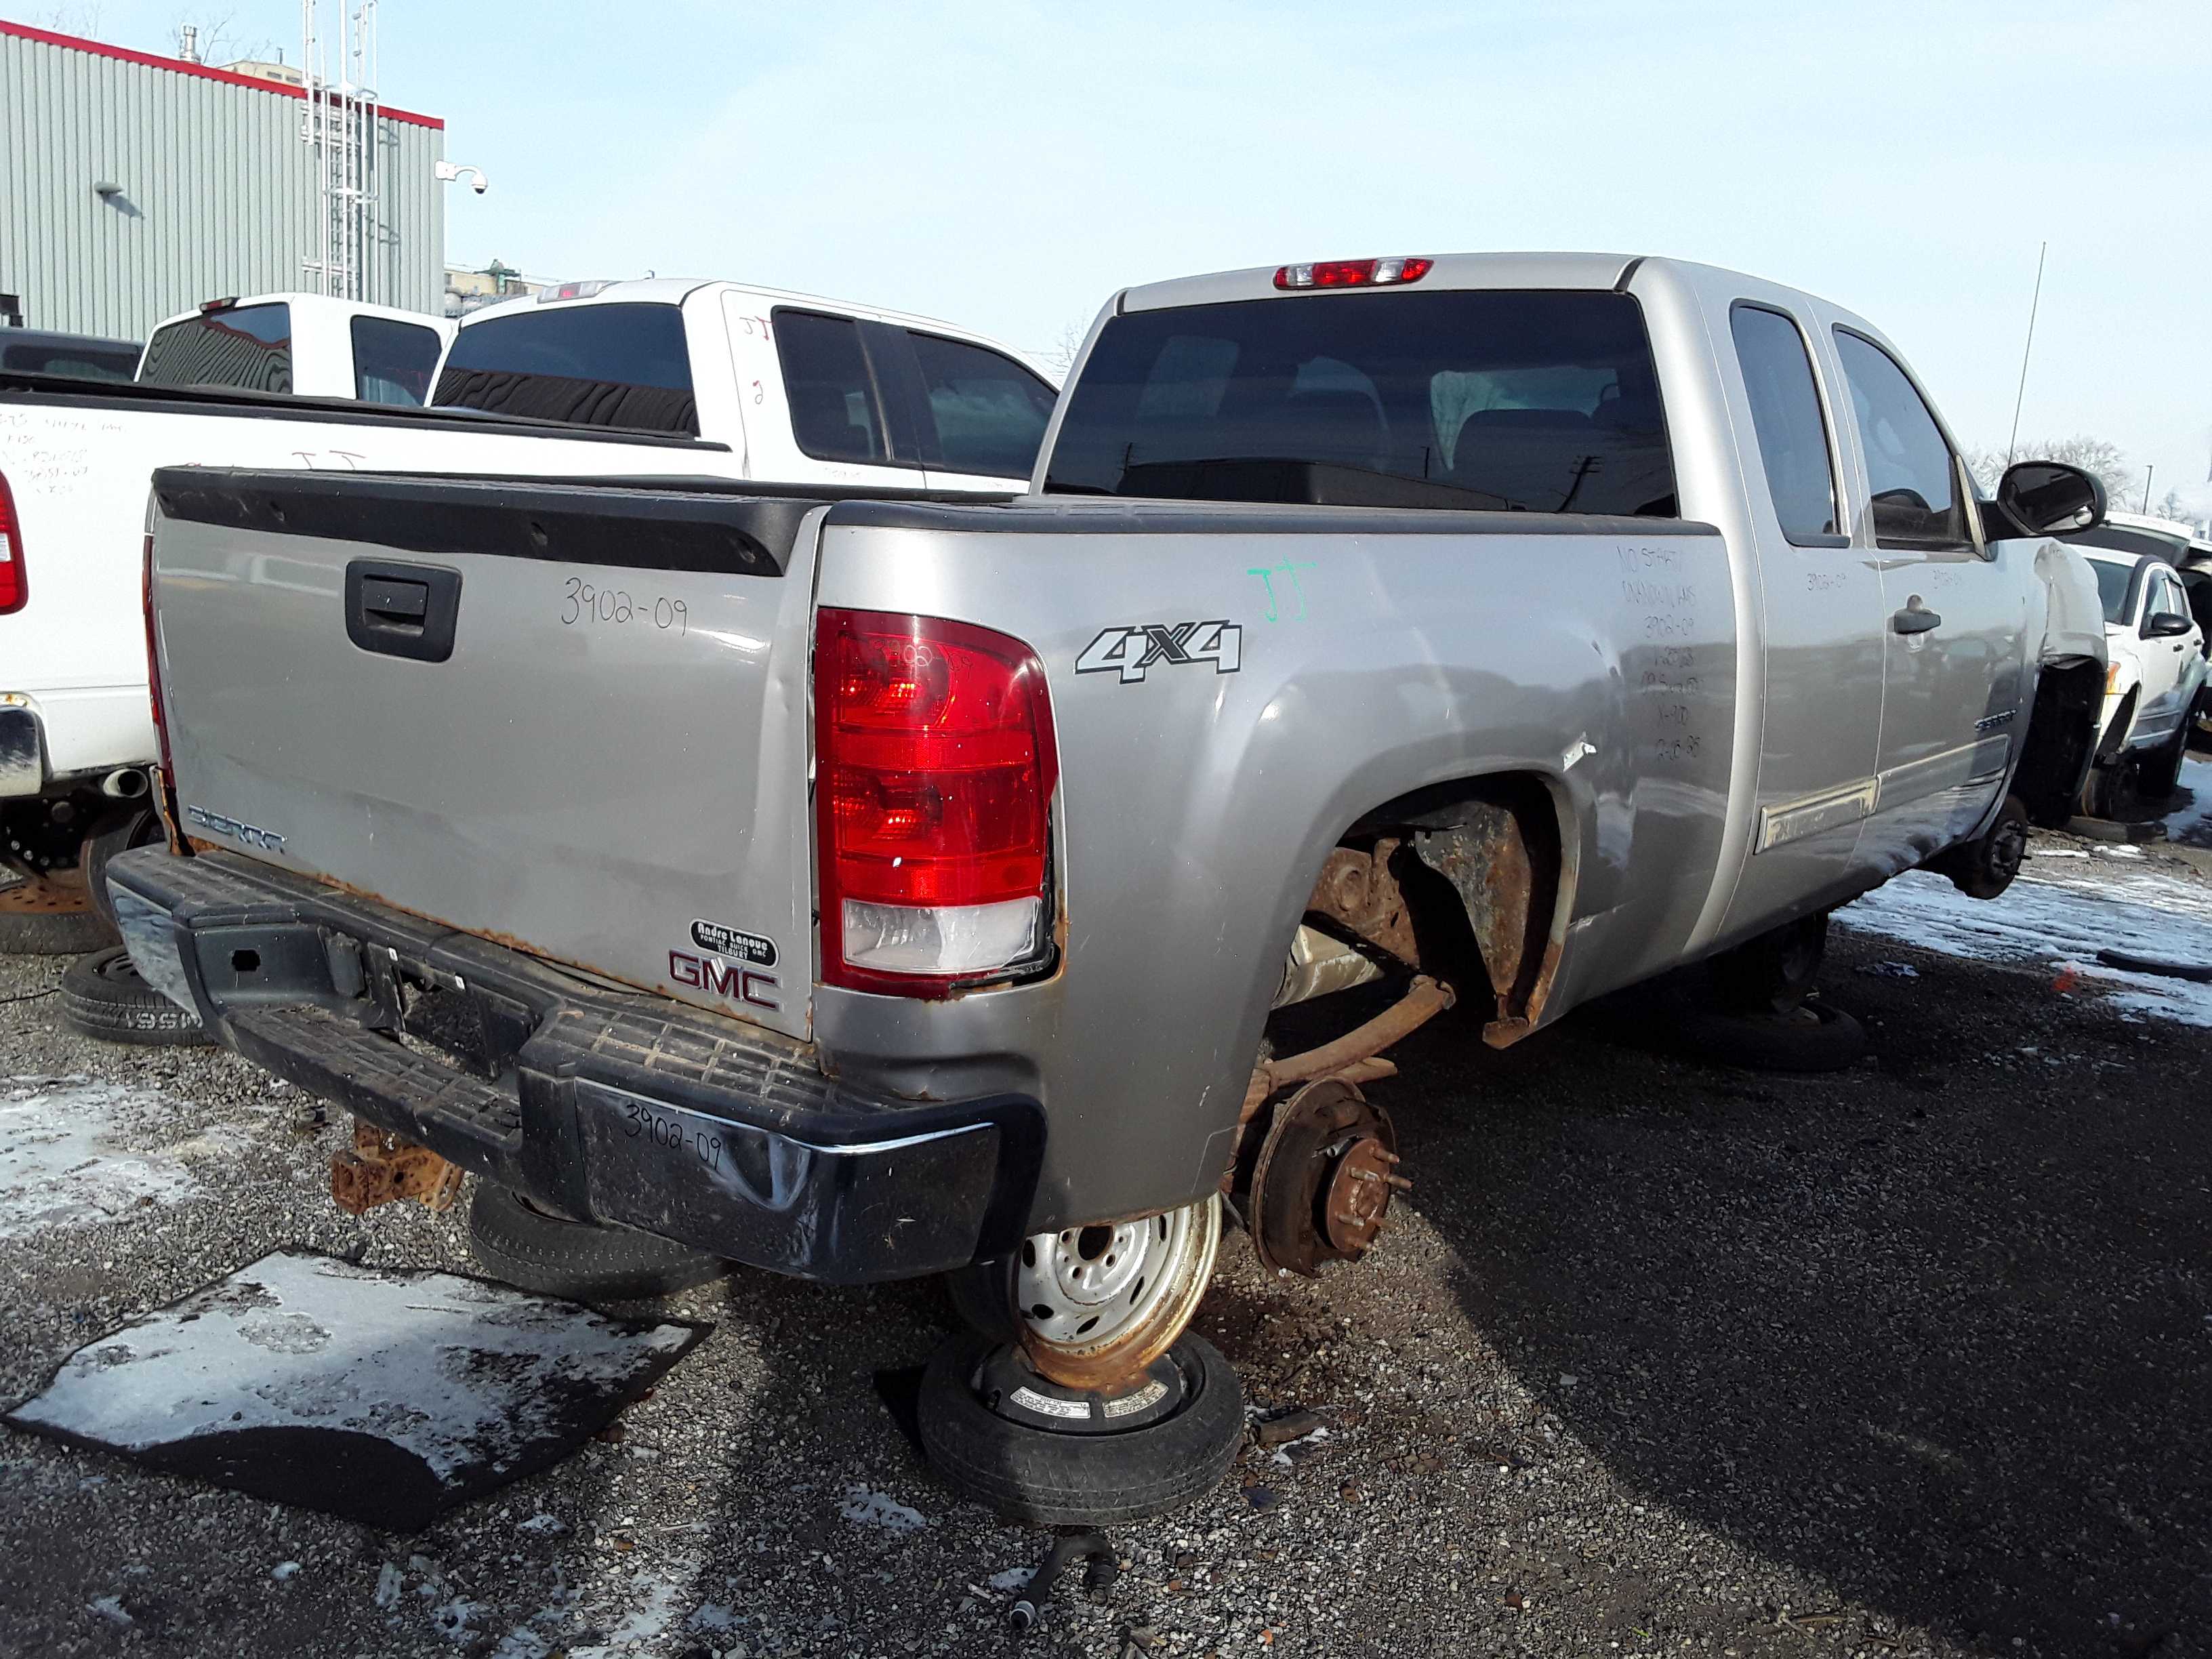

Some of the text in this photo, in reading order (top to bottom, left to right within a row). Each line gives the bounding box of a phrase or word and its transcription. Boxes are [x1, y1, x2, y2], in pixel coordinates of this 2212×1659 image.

[561, 577, 687, 638] 3902-09
[697, 922, 728, 941] Andre
[700, 934, 726, 946] PONTIAC
[718, 945, 749, 960] TILBURY
[669, 949, 783, 1012] GMC
[625, 1104, 722, 1170] 3902-09
